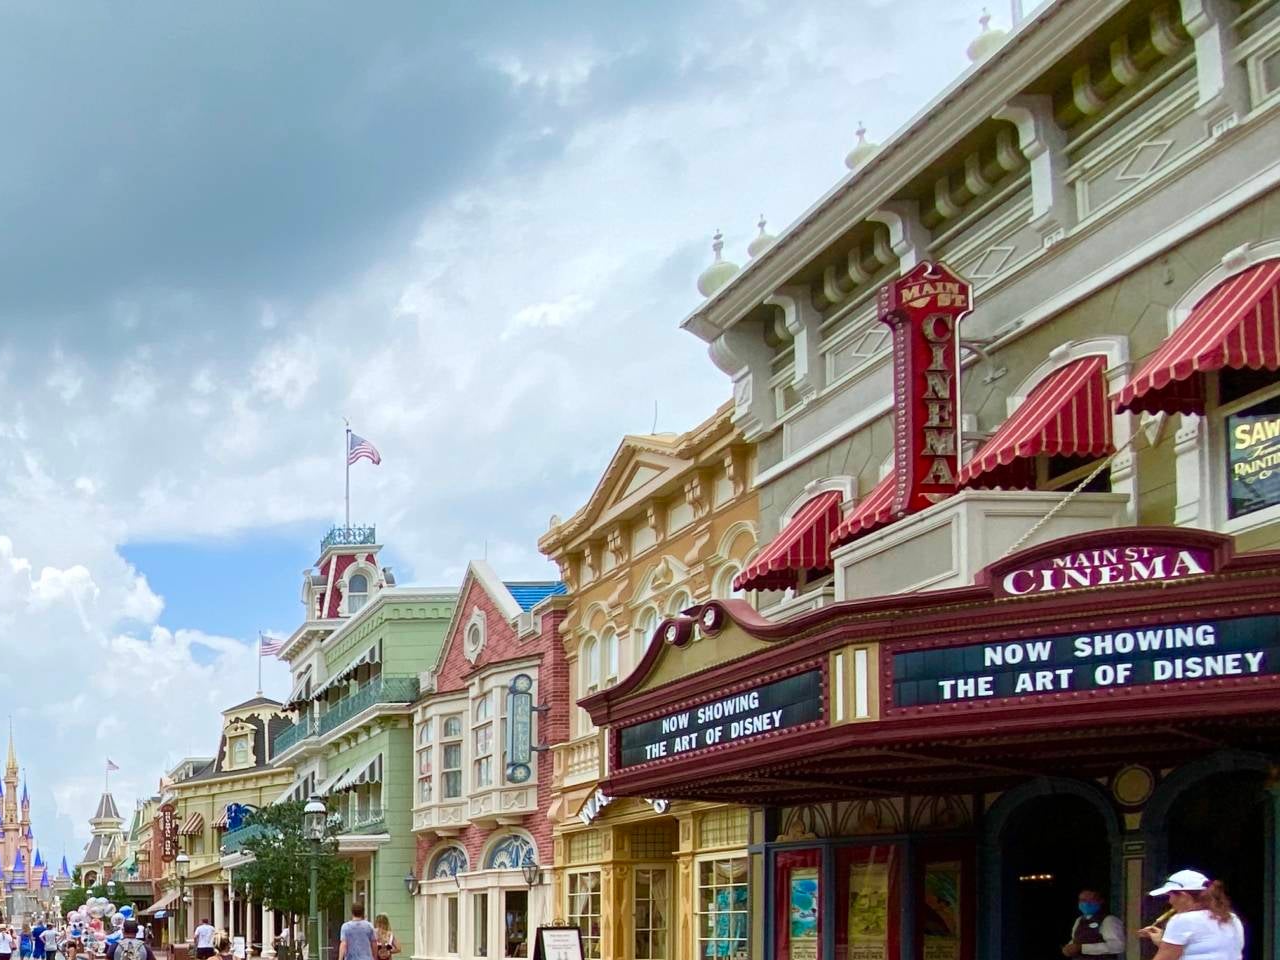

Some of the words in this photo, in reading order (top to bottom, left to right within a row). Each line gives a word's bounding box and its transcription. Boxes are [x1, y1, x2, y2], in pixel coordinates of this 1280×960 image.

[900, 281, 960, 305] MAIN
[920, 312, 957, 485] CINEMA
[1002, 550, 1206, 595] CINEMA
[1052, 548, 1118, 568] MAIN
[983, 641, 1052, 667] NOW
[1073, 624, 1216, 658] SHOWING
[938, 676, 994, 700] THE
[1015, 668, 1073, 693] ART
[1094, 663, 1132, 686] OF
[1153, 651, 1265, 681] DISNEY
[645, 741, 667, 760] THE
[673, 732, 698, 753] ART
[705, 726, 722, 745] OF
[730, 709, 783, 739] DISNEY
[662, 712, 690, 734] NOW
[697, 691, 760, 724] SHOWING
